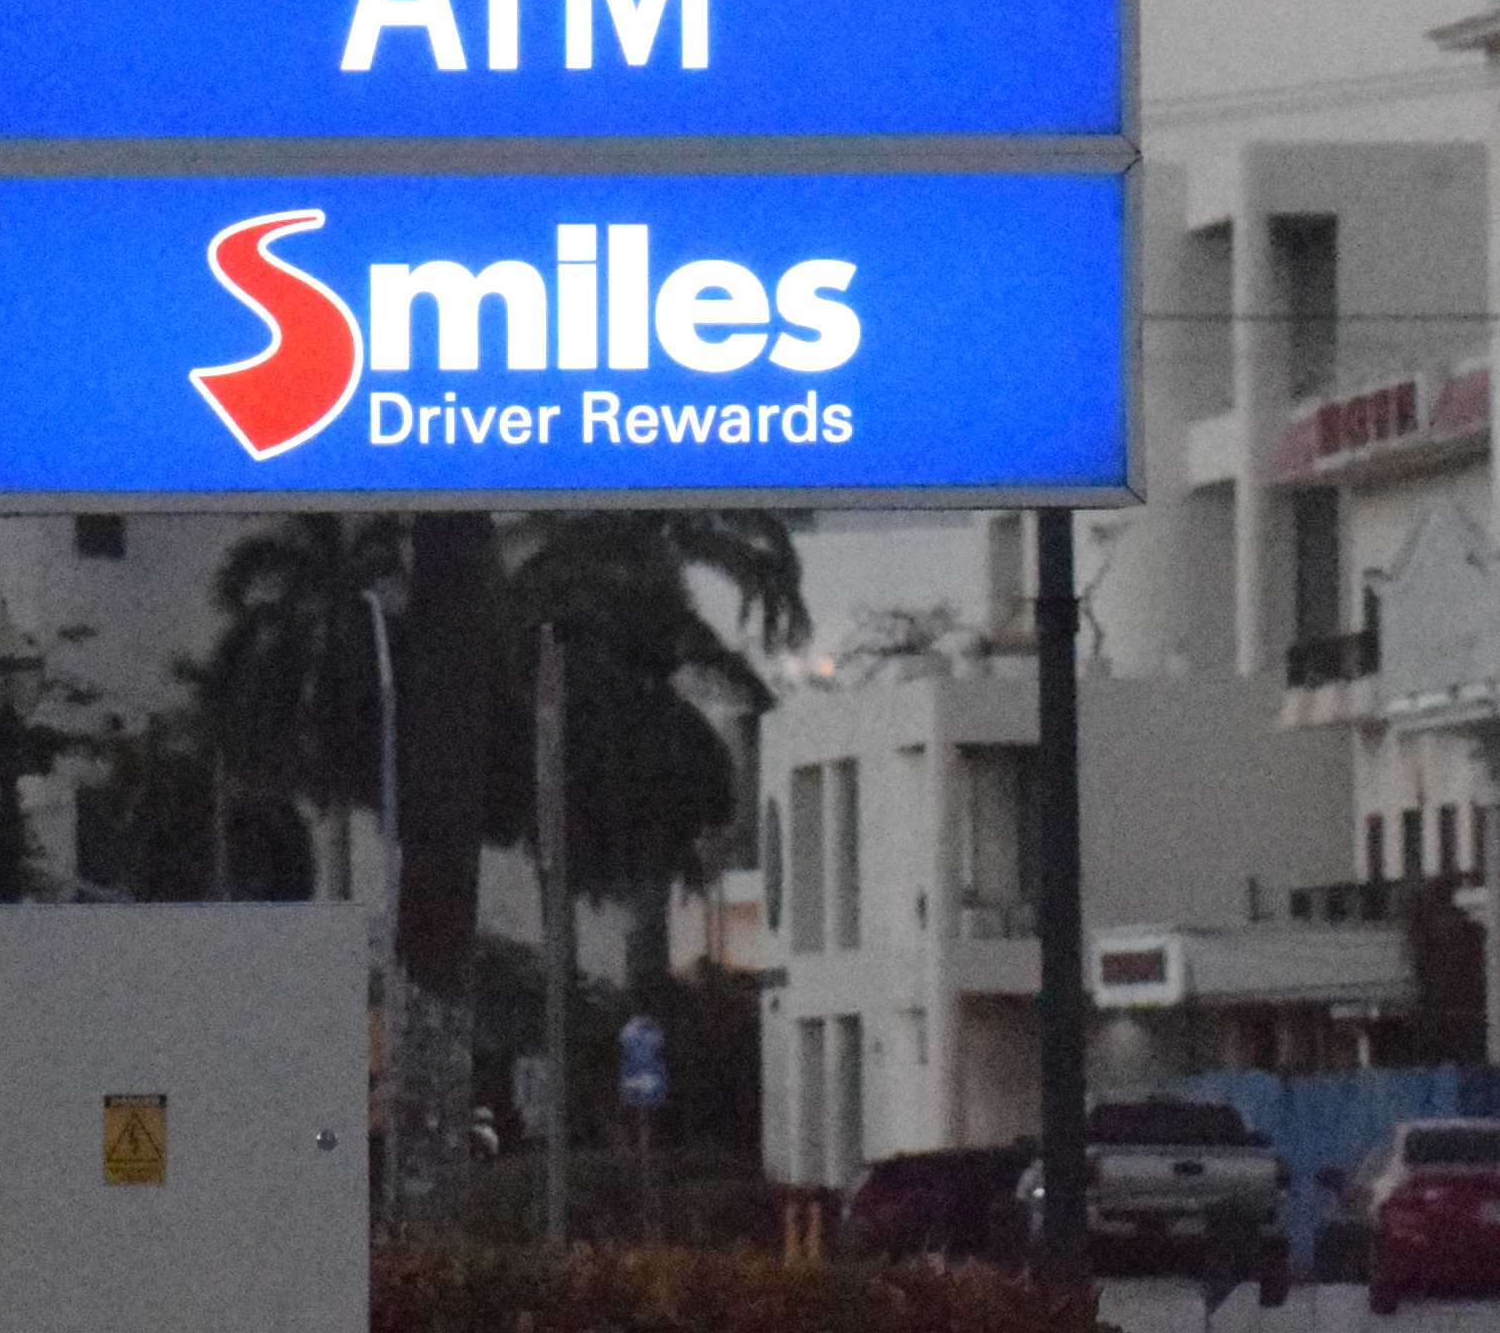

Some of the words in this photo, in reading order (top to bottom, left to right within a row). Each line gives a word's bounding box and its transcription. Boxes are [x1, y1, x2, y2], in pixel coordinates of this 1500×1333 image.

[187, 207, 863, 463] Smiles
[369, 390, 563, 446] Driver
[581, 388, 854, 446] Rewards
